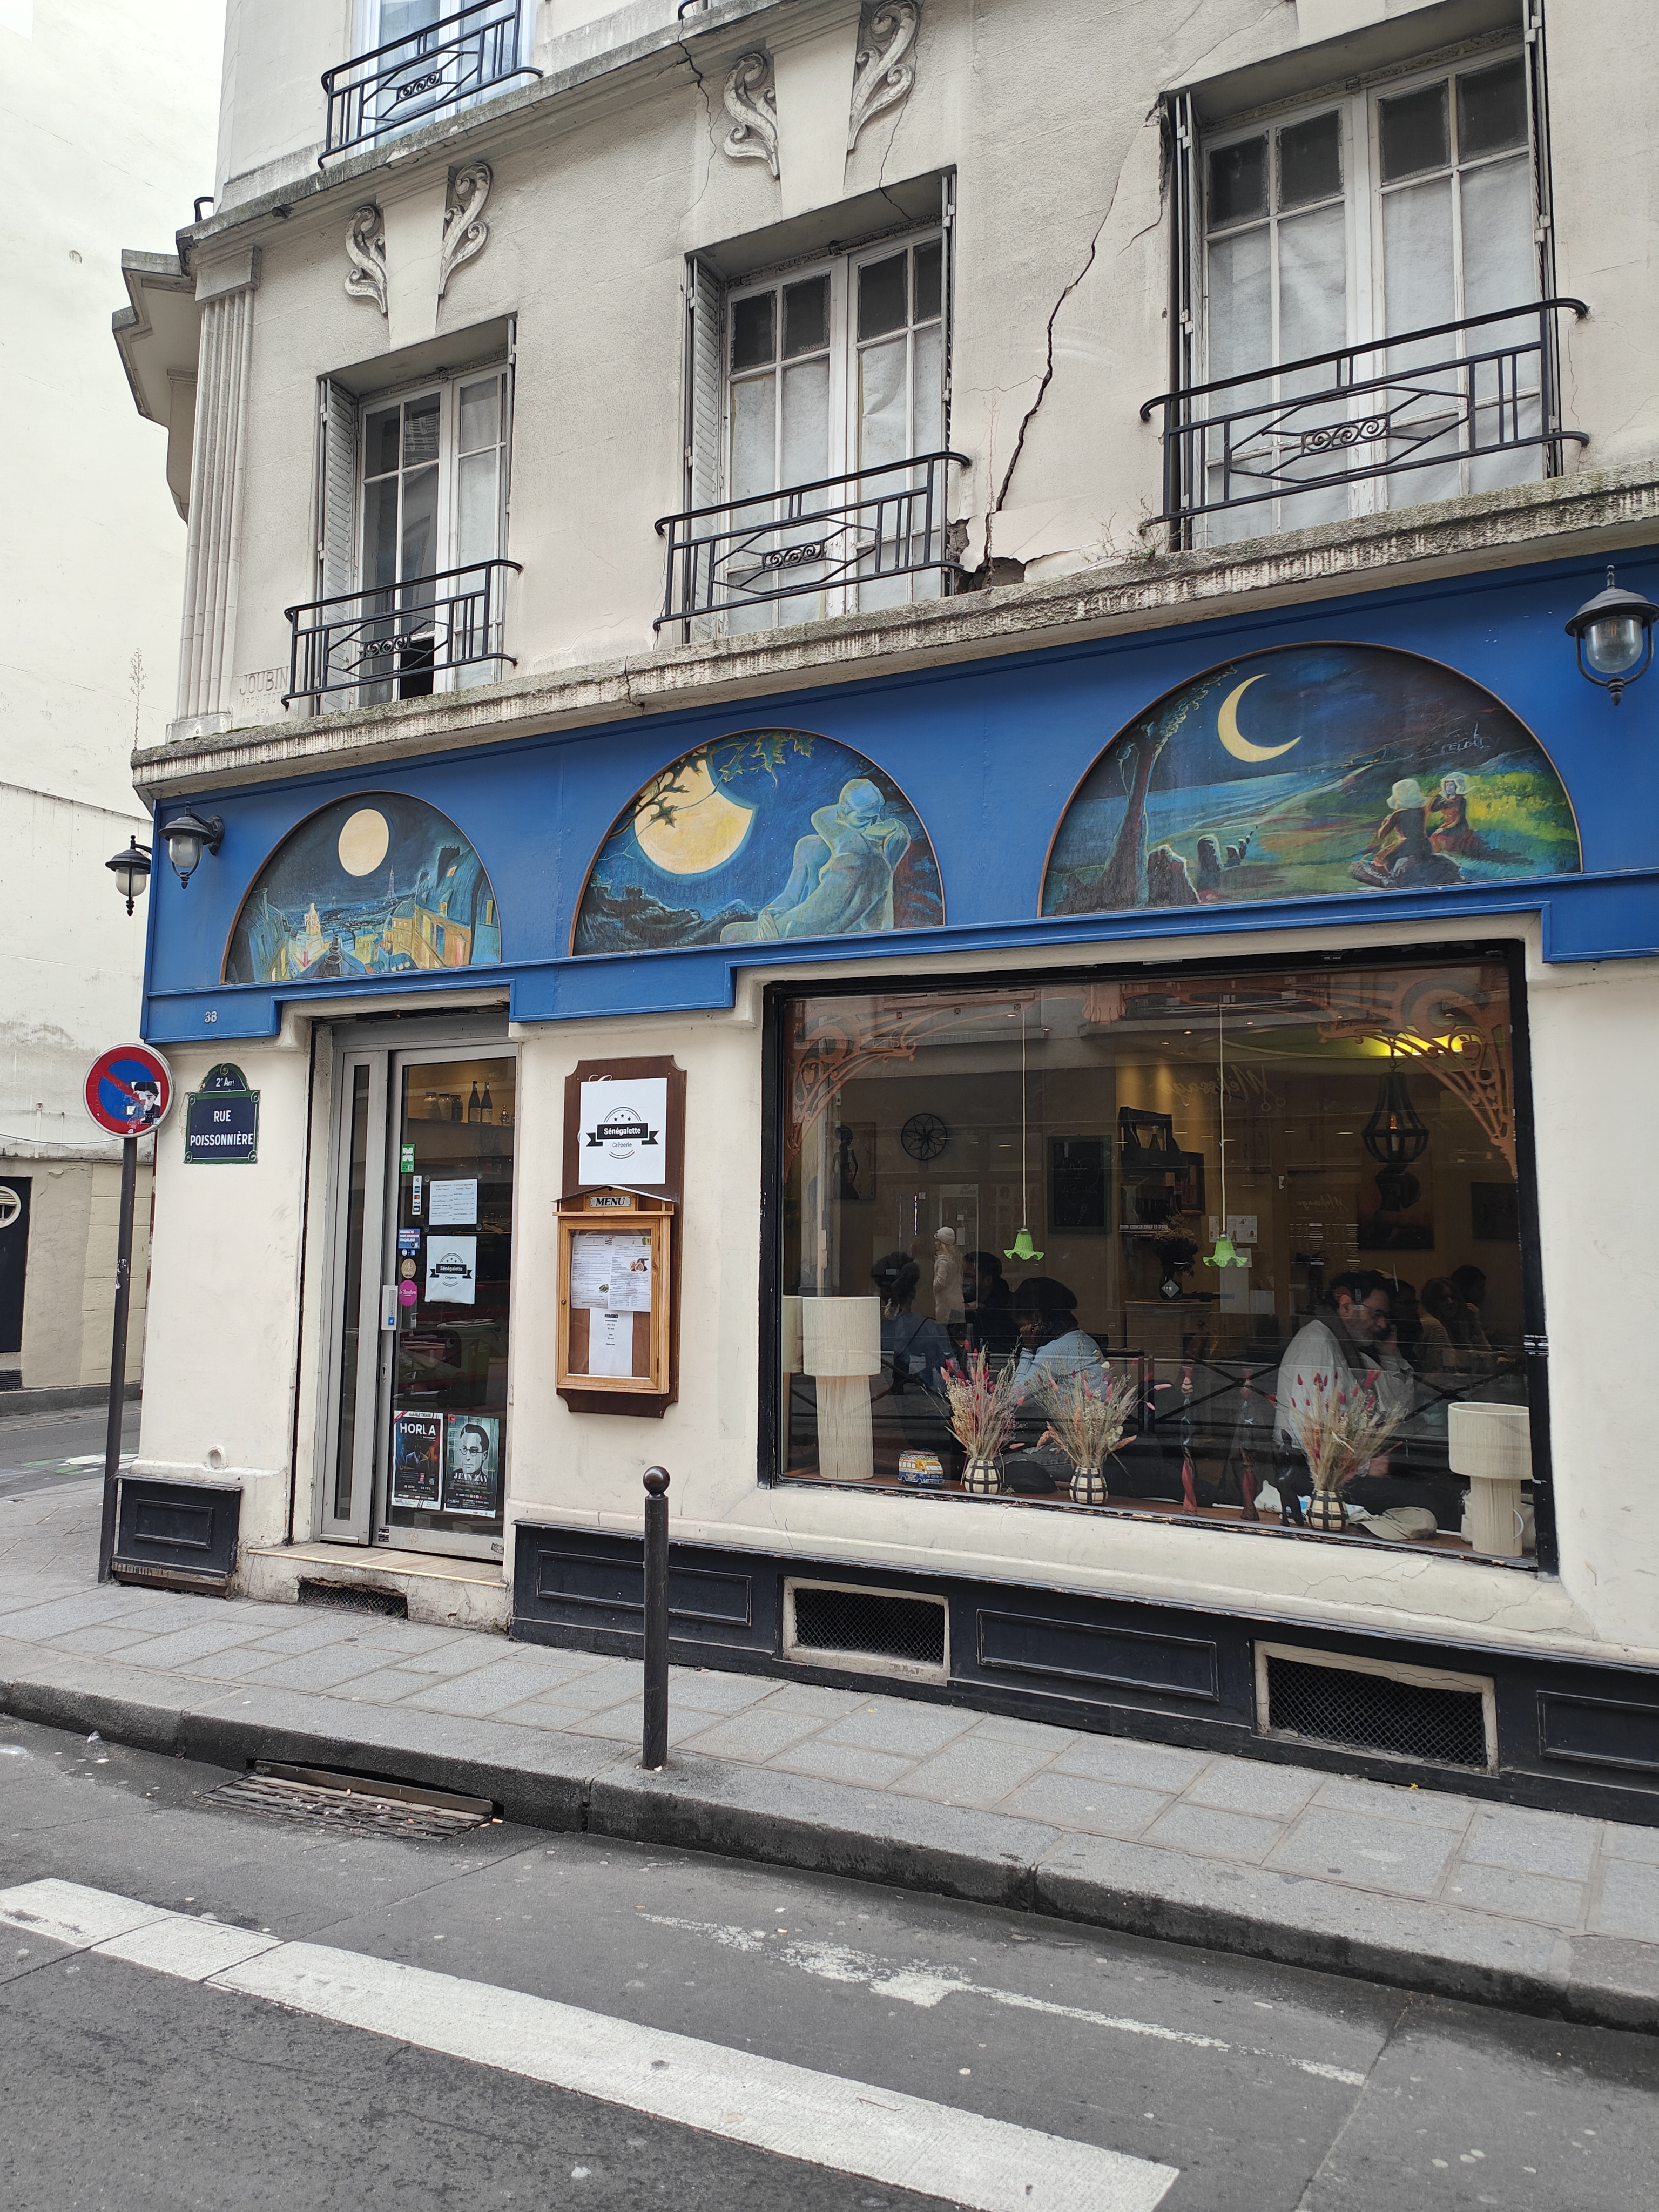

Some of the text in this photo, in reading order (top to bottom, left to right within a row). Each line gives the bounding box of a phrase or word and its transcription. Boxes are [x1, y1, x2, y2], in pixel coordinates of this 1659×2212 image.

[239, 667, 288, 696] JOUBIN
[204, 1011, 217, 1023] 38
[213, 1110, 232, 1122] RUE
[603, 1127, 642, 1136] Sénégalette
[190, 1132, 254, 1147] POISSONNIÈRE
[595, 1197, 626, 1206] MENU
[400, 1422, 436, 1436] HORLA
